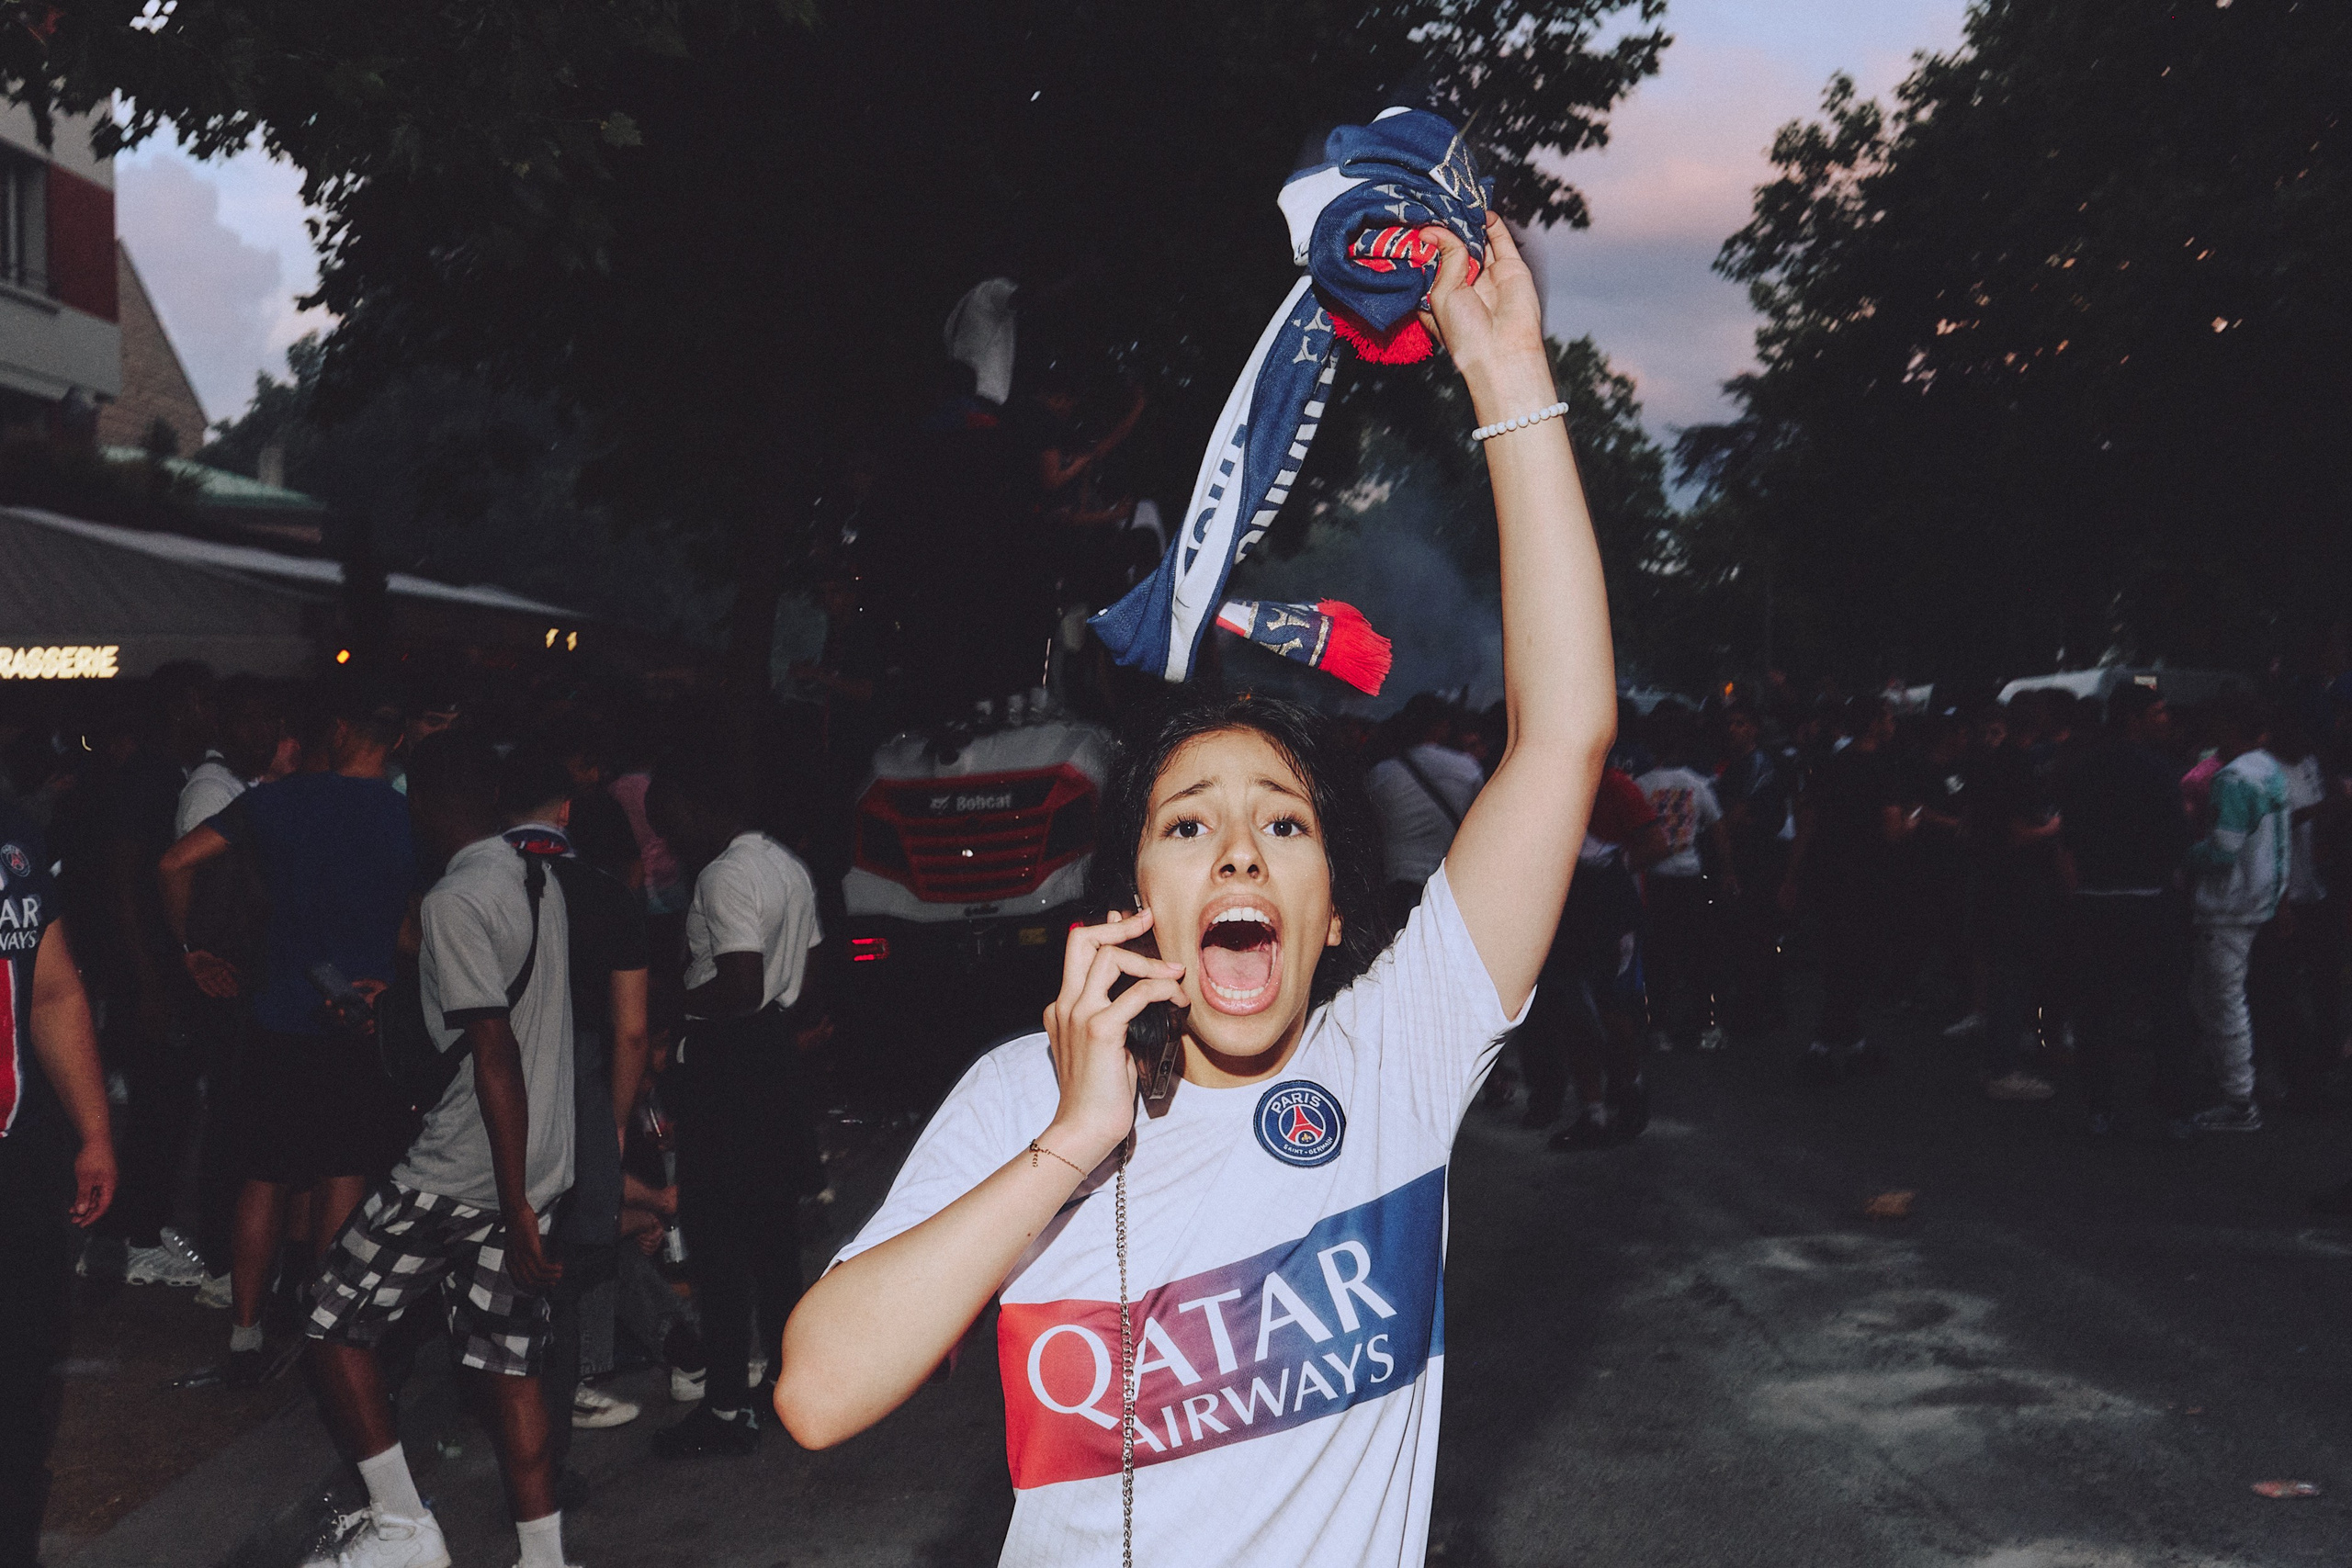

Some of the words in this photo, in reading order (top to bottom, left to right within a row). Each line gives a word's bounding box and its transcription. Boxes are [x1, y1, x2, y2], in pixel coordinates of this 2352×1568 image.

[956, 794, 1012, 811] Bobcat
[1271, 1092, 1321, 1114] PARIS
[1026, 1240, 1397, 1430] QATAR
[1129, 1333, 1396, 1453] AIRWAYS
